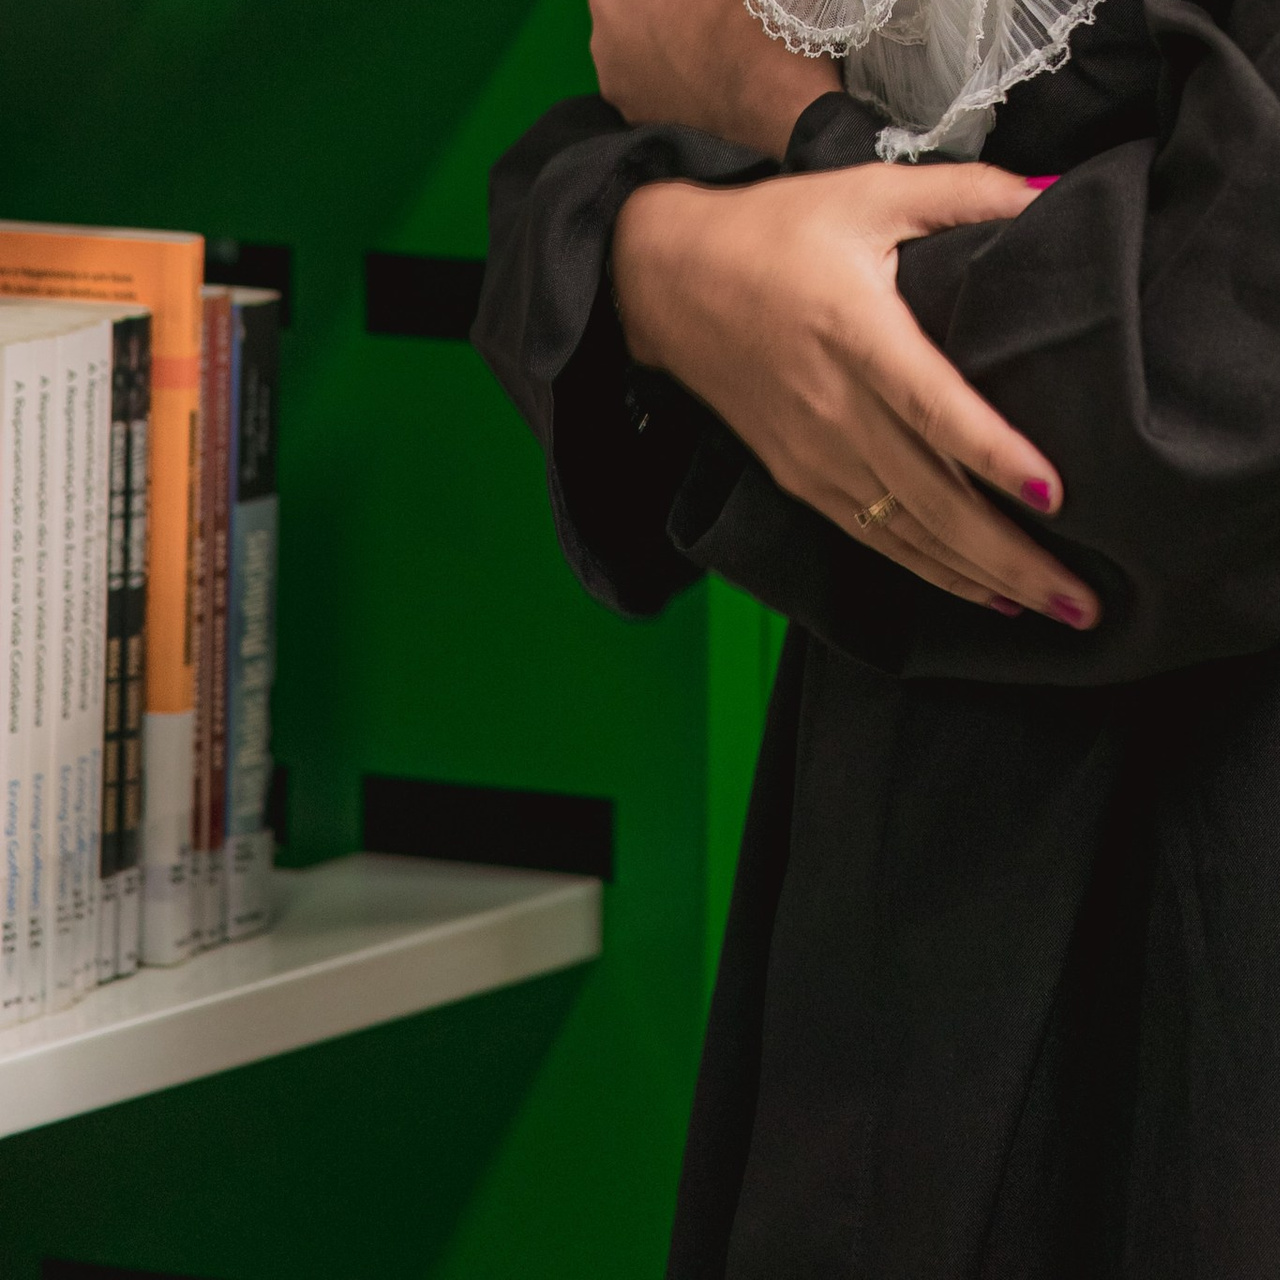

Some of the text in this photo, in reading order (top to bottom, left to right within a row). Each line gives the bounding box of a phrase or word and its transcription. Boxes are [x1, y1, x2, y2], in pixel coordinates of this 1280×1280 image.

[15, 381, 25, 393] A
[41, 376, 50, 387] A
[67, 369, 77, 382] A
[13, 529, 23, 552] do
[12, 583, 21, 604] na
[12, 607, 22, 646] Vida
[10, 649, 22, 734] Cotidiana
[35, 644, 46, 727] Cotidiana
[62, 636, 75, 720] Cotidiana
[6, 780, 20, 837] Erving
[7, 840, 20, 916] Goffman
